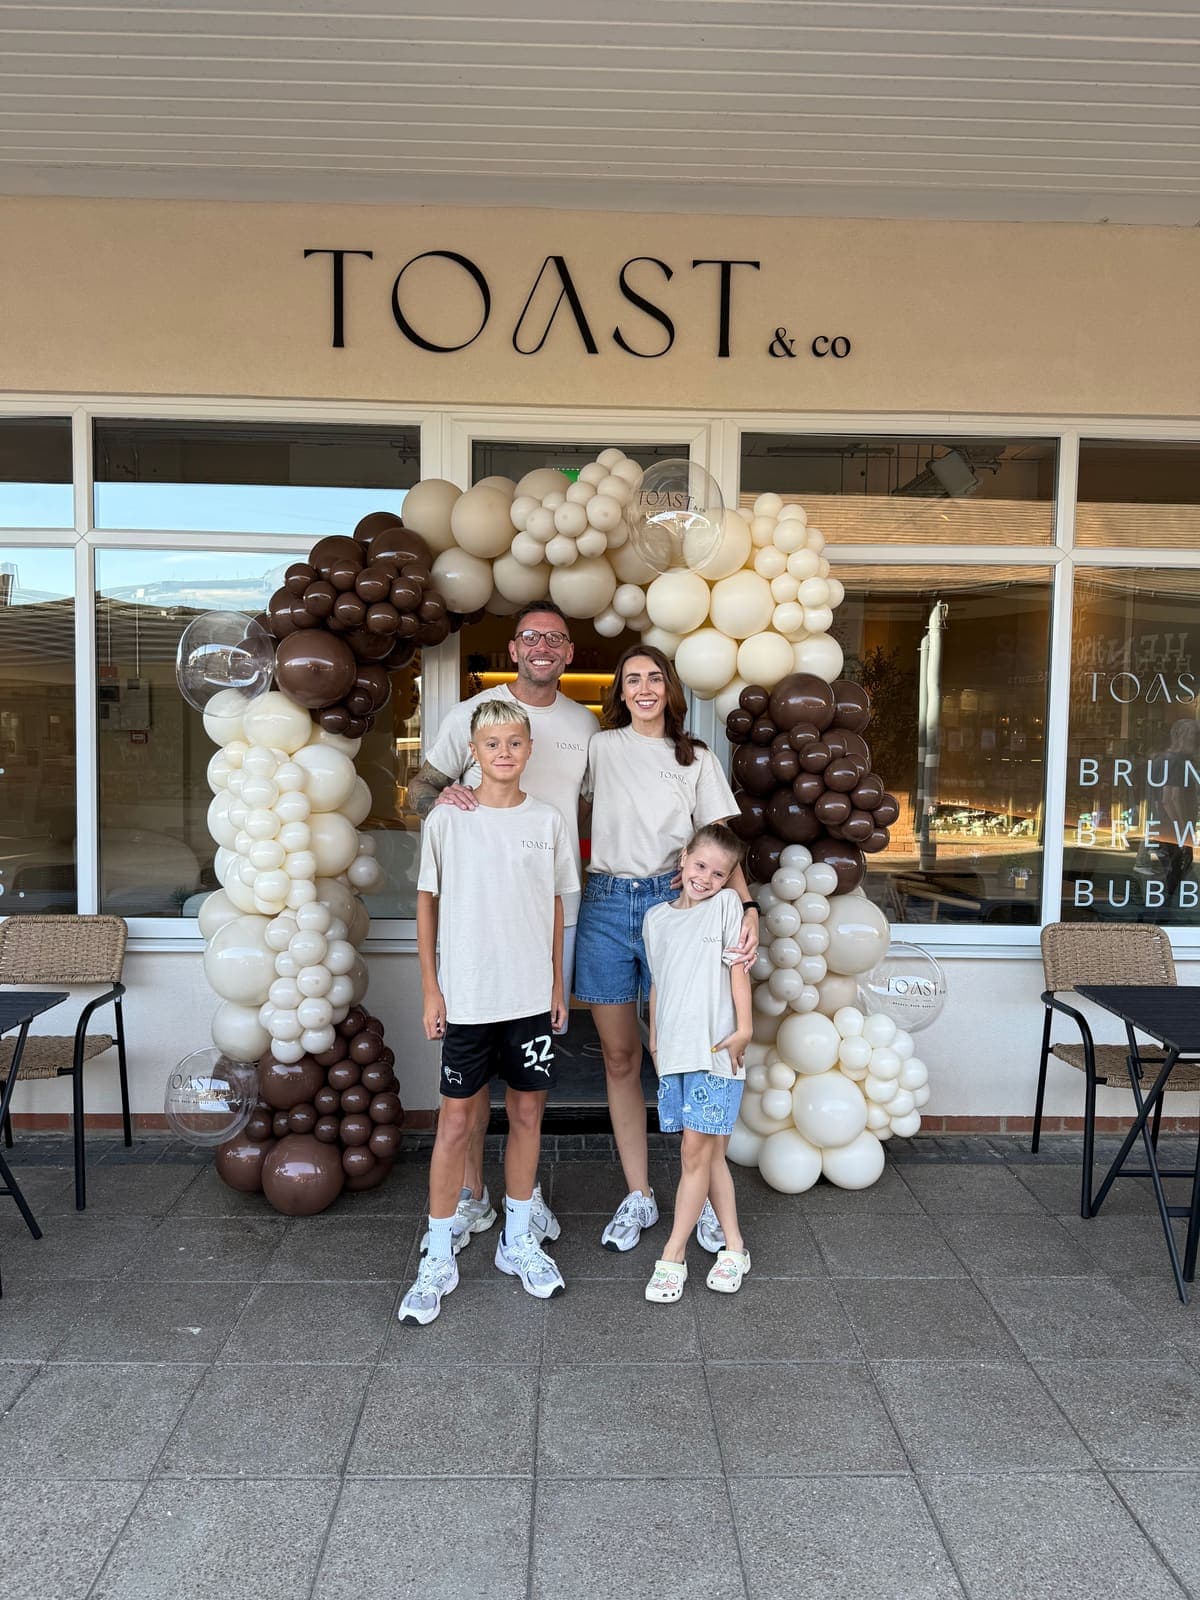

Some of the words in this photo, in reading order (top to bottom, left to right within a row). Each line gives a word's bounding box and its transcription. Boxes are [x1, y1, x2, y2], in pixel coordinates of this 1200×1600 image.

[304, 249, 760, 358] TOAST
[768, 327, 797, 358] &
[811, 335, 851, 358] co
[639, 490, 695, 511] TOAST
[521, 839, 548, 850] TOAST
[885, 977, 938, 996] TOAST
[521, 1034, 555, 1068] 32
